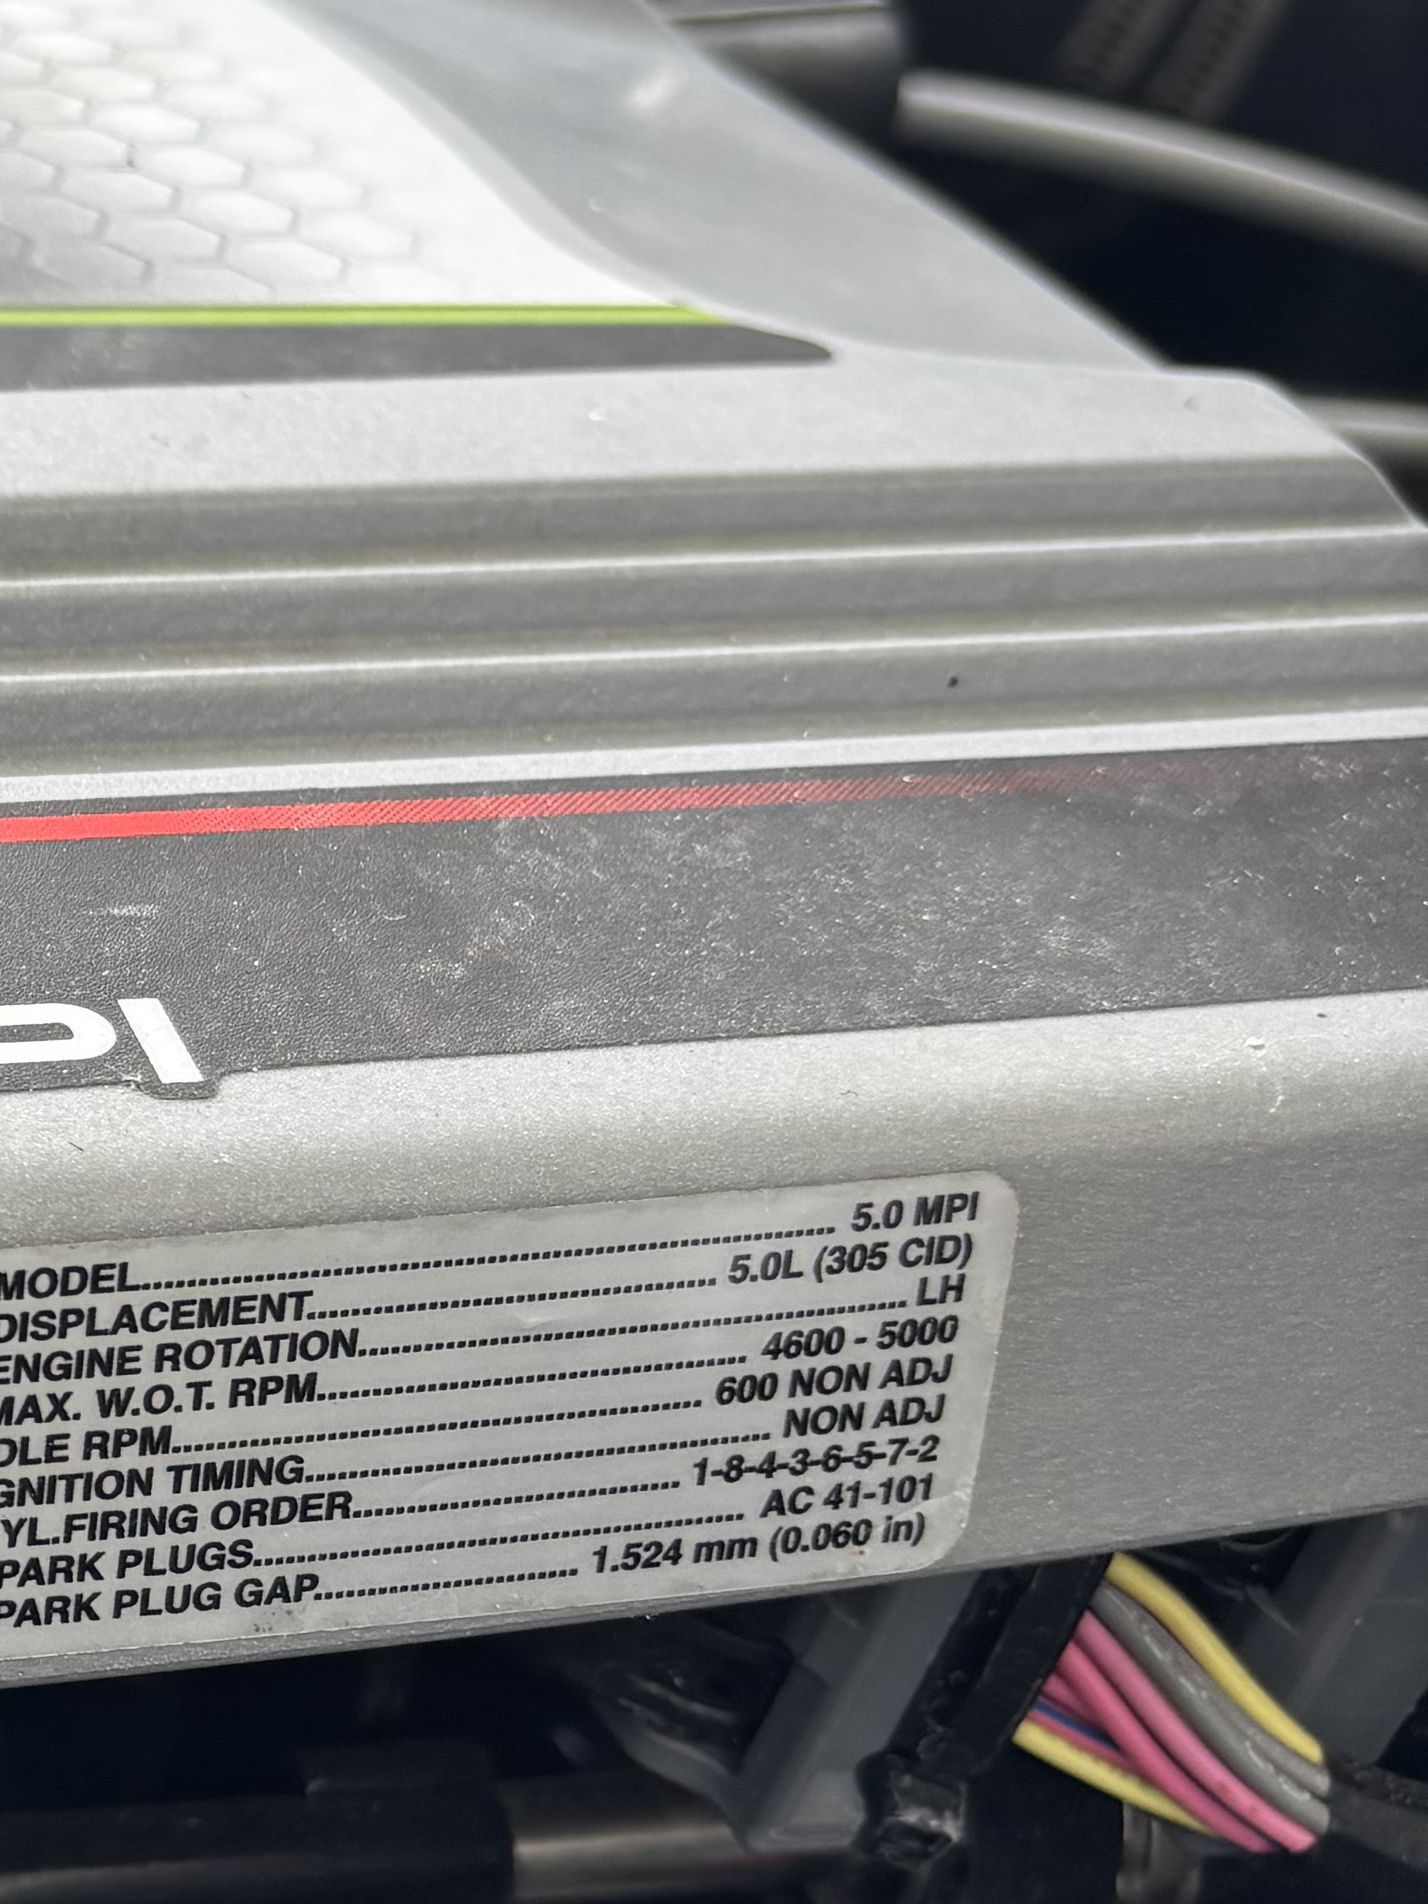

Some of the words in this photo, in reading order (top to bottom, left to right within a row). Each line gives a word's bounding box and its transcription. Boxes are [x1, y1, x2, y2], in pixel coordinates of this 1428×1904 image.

[850, 1199, 904, 1233] 5.0
[912, 1190, 981, 1226] MPI
[727, 1249, 804, 1284] 5.0L
[812, 1241, 888, 1283] (305
[897, 1231, 974, 1269] CID)
[916, 1273, 967, 1307] LH
[97, 1382, 216, 1419] W.O.T.
[228, 1371, 319, 1407] RPM
[761, 1324, 846, 1361] 4600
[875, 1314, 960, 1352] 5000
[81, 1426, 173, 1461] RPM
[715, 1372, 778, 1406] 600
[787, 1361, 871, 1398] NON
[877, 1354, 955, 1389] ADJ
[782, 1402, 865, 1438] NON
[871, 1394, 947, 1430] ADJ
[691, 1434, 942, 1487] 1-8-4-3-6-5-7-2
[760, 1484, 815, 1518] AC
[822, 1473, 934, 1511] 41-101
[111, 1575, 222, 1620] PLUG
[233, 1571, 320, 1607] GAP
[591, 1538, 683, 1576] 1.524
[691, 1532, 759, 1564] mm
[767, 1519, 872, 1562] (0.060
[880, 1512, 927, 1547] in)
